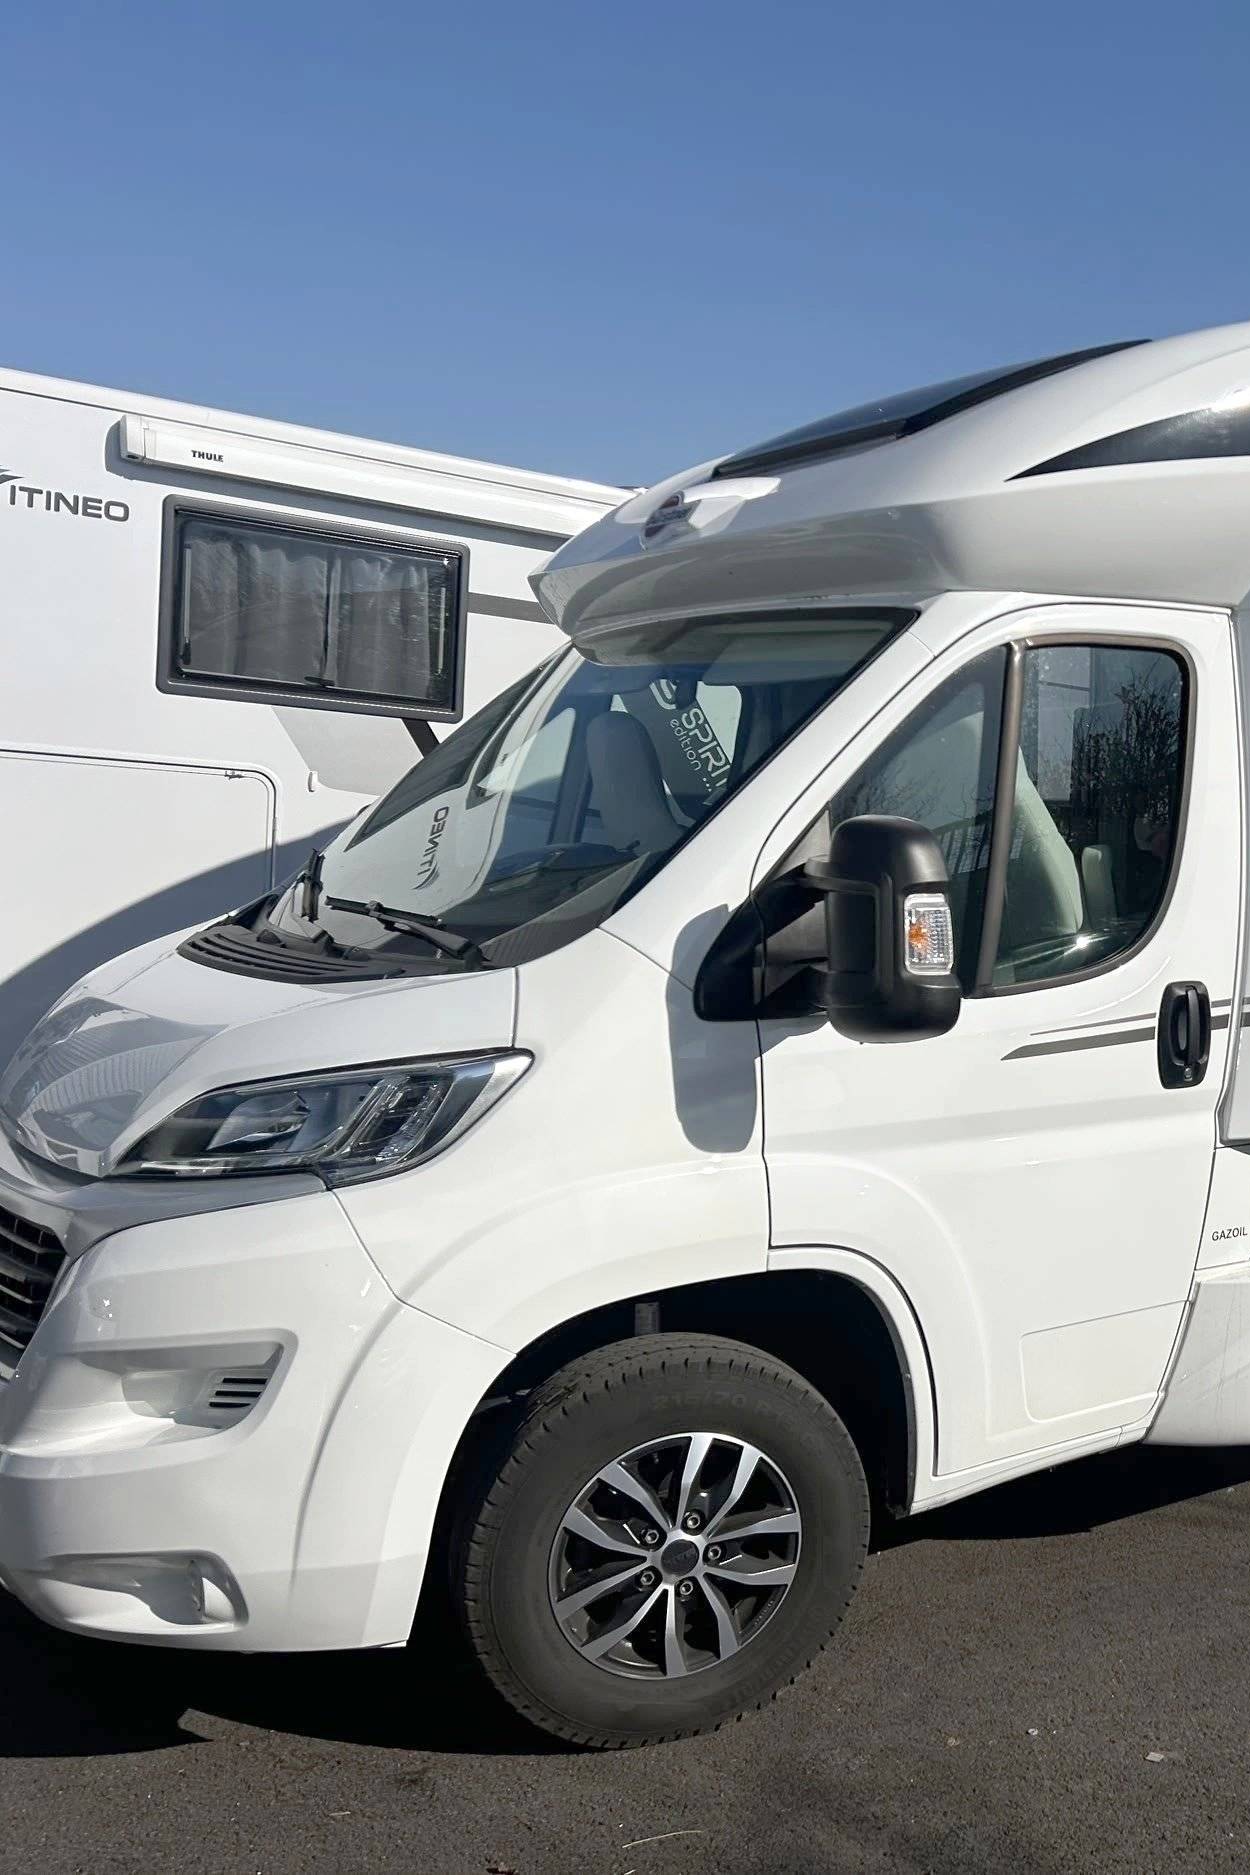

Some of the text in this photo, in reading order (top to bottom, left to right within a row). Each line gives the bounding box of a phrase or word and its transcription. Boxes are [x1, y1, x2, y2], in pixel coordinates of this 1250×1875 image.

[191, 449, 224, 463] THULE
[9, 484, 130, 523] ITINEO
[669, 719, 702, 771] edition
[1211, 1226, 1248, 1241] GAZOIL
